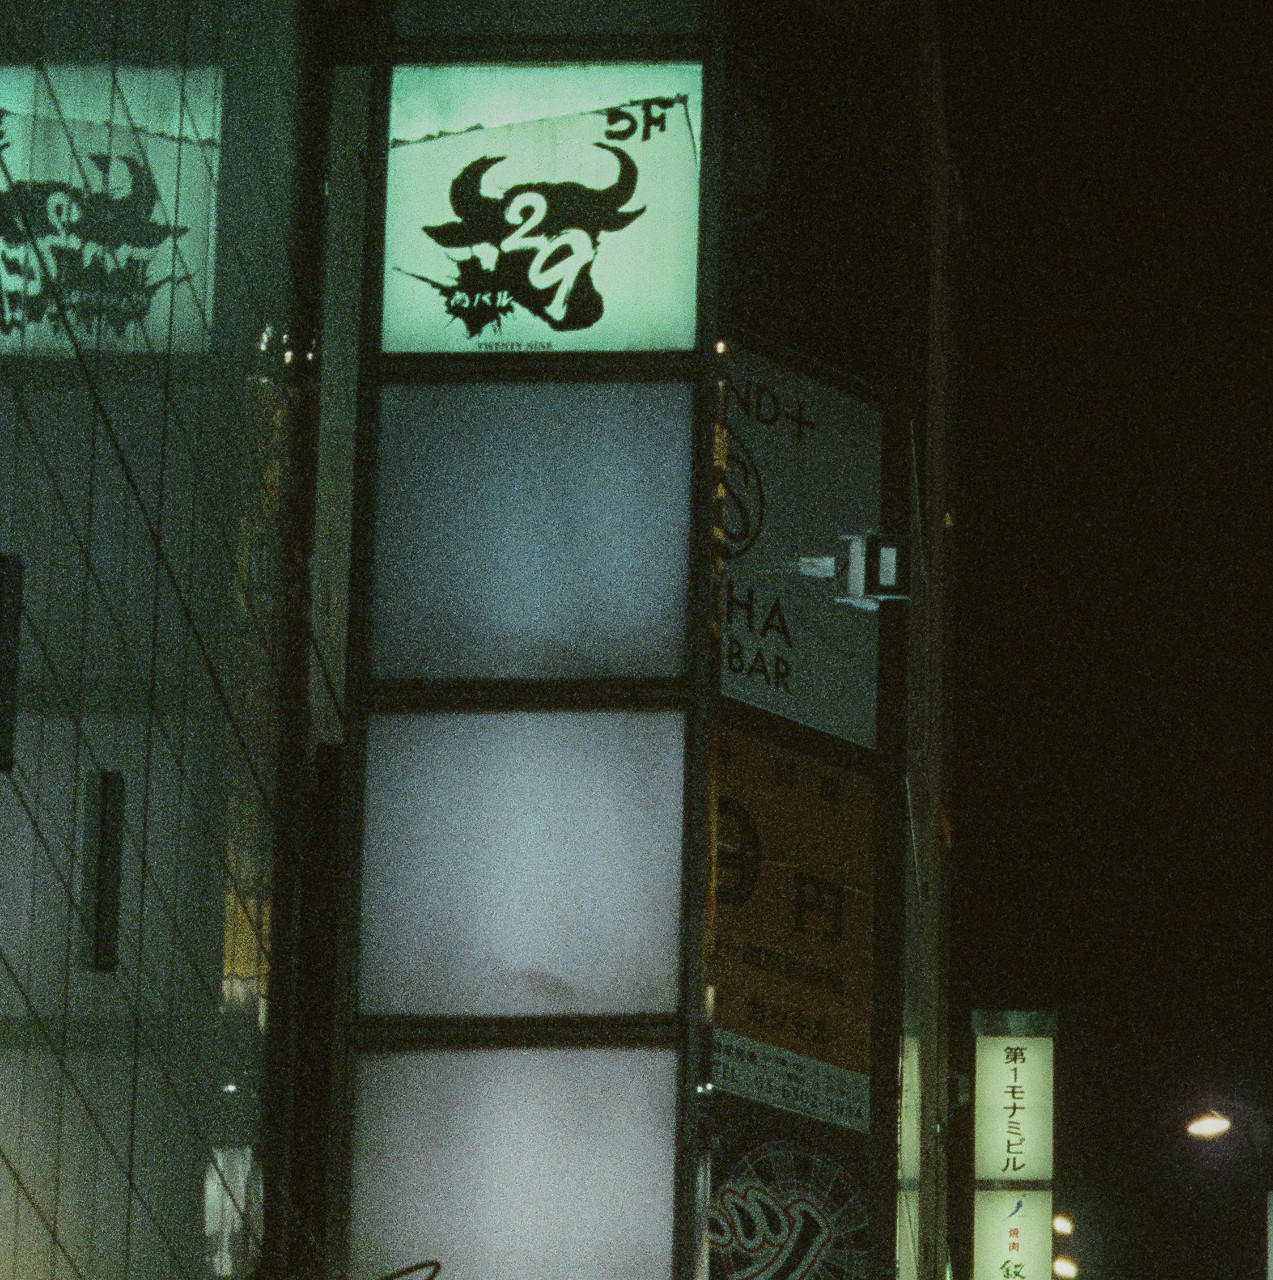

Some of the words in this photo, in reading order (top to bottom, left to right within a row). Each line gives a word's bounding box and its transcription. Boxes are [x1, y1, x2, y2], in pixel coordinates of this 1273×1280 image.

[501, 191, 592, 320] 29
[1001, 1046, 1028, 1173] 第1モナミビル
